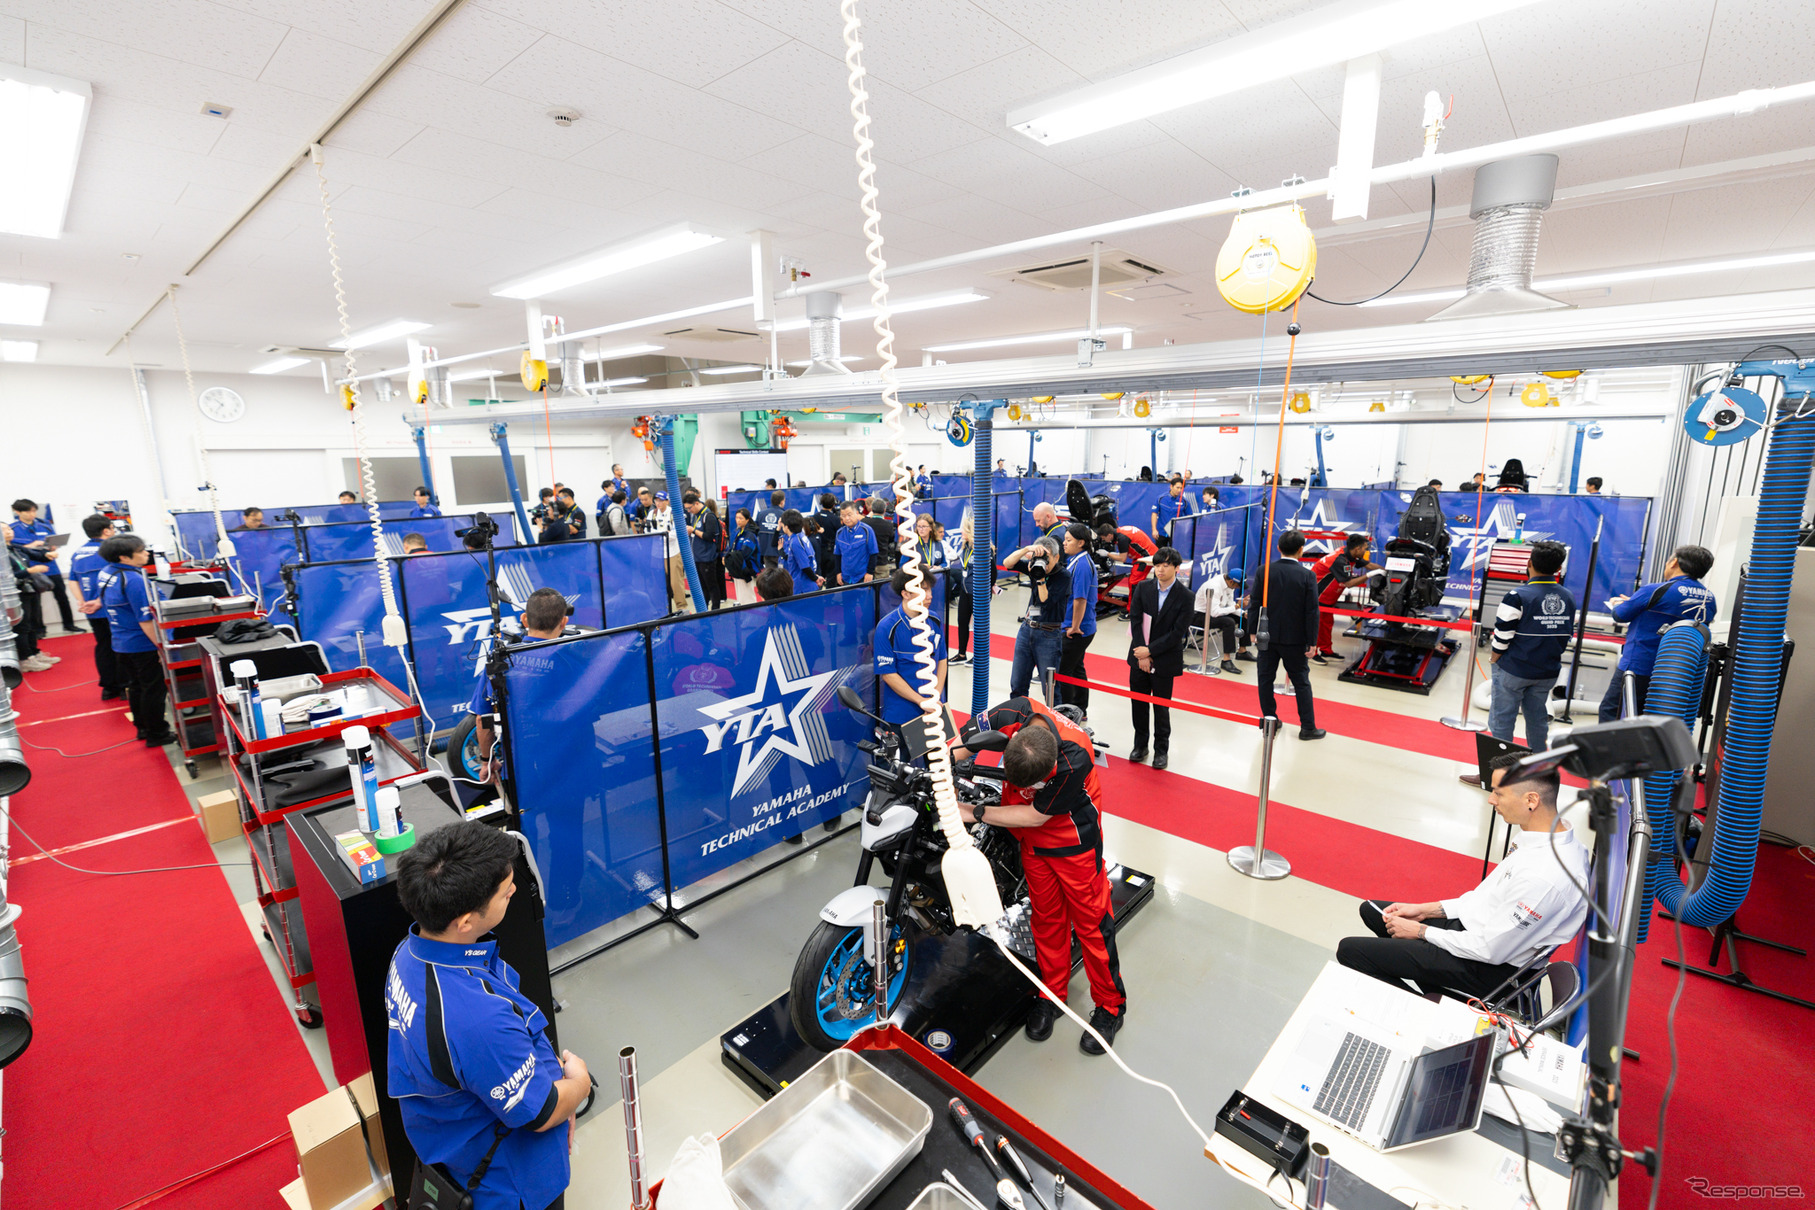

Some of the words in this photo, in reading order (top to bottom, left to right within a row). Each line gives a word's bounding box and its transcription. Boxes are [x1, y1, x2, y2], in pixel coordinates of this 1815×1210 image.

[1200, 558, 1220, 576] YTA
[698, 702, 789, 755] YTA
[701, 812, 783, 857] TECHNICAL
[786, 783, 850, 820] ACADEMY
[752, 784, 812, 817] YAMAHA
